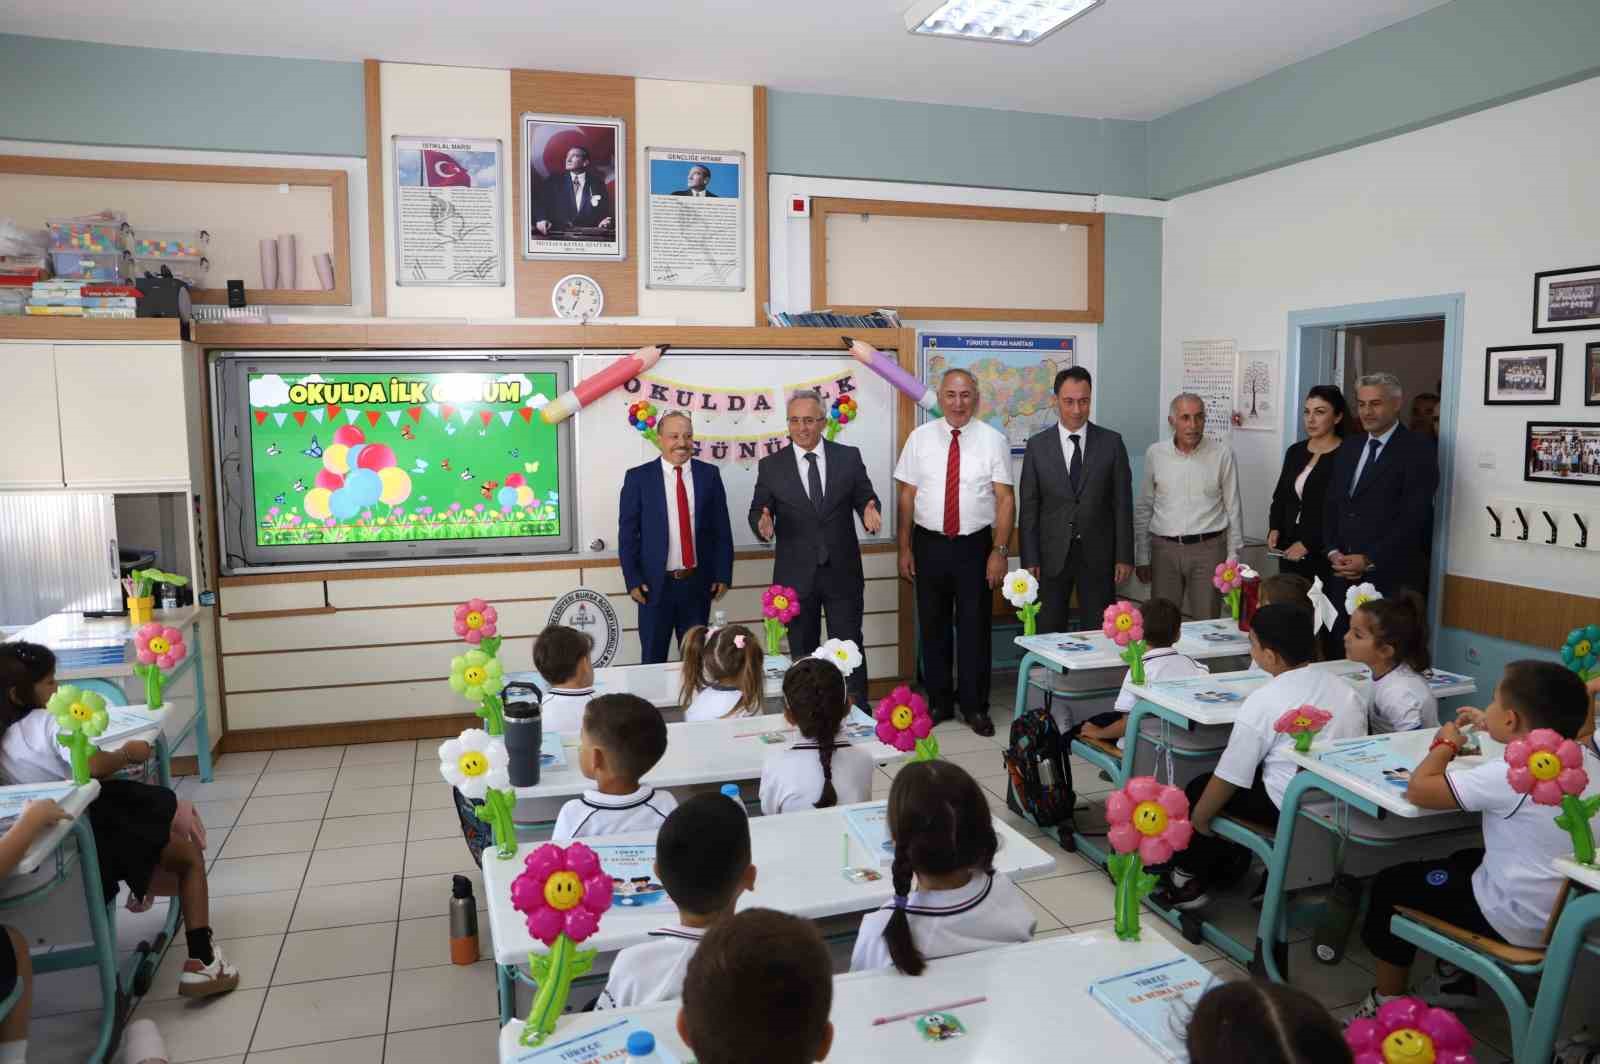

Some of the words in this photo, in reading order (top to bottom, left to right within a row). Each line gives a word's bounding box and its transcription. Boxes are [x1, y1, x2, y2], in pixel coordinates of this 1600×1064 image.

[288, 381, 387, 405] OKULDA
[390, 377, 428, 404] İLK
[622, 377, 771, 412] OKULDA
[812, 374, 857, 400] LK
[575, 592, 598, 601] BURSA
